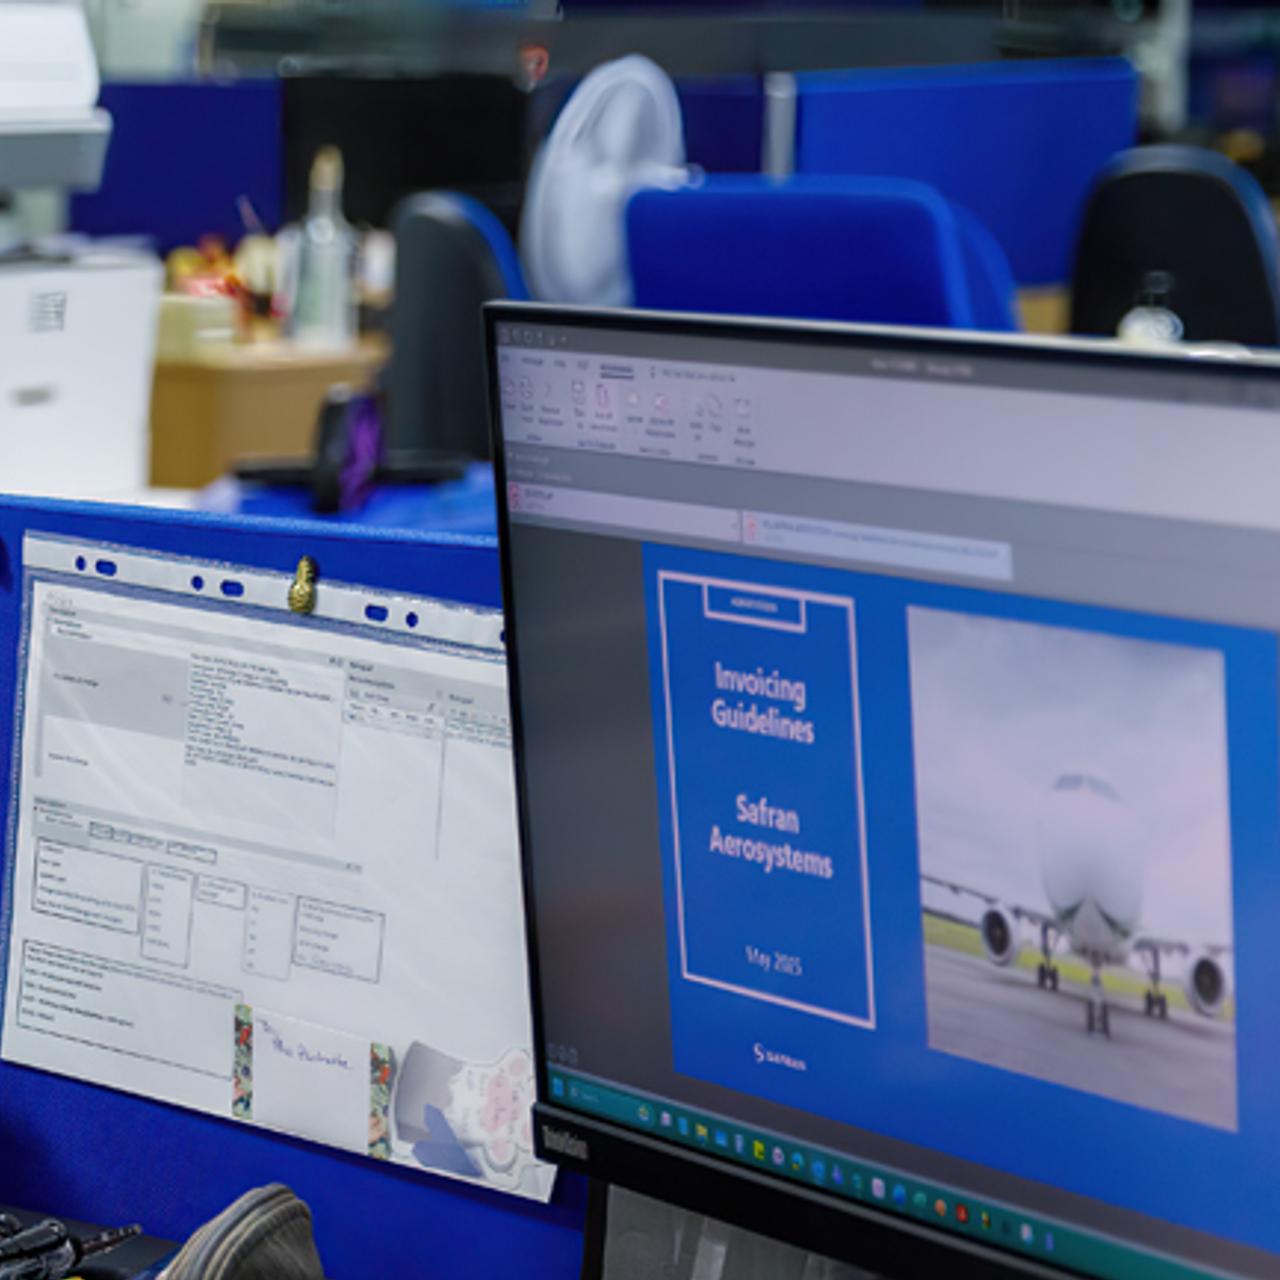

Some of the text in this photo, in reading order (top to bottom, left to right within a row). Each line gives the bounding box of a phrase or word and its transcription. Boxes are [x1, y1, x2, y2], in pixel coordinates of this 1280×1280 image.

[714, 661, 807, 713] Invoicing
[711, 697, 815, 745] Guidelines
[736, 793, 801, 834] Safran
[709, 824, 834, 879] Aerosystems
[745, 945, 771, 972] May
